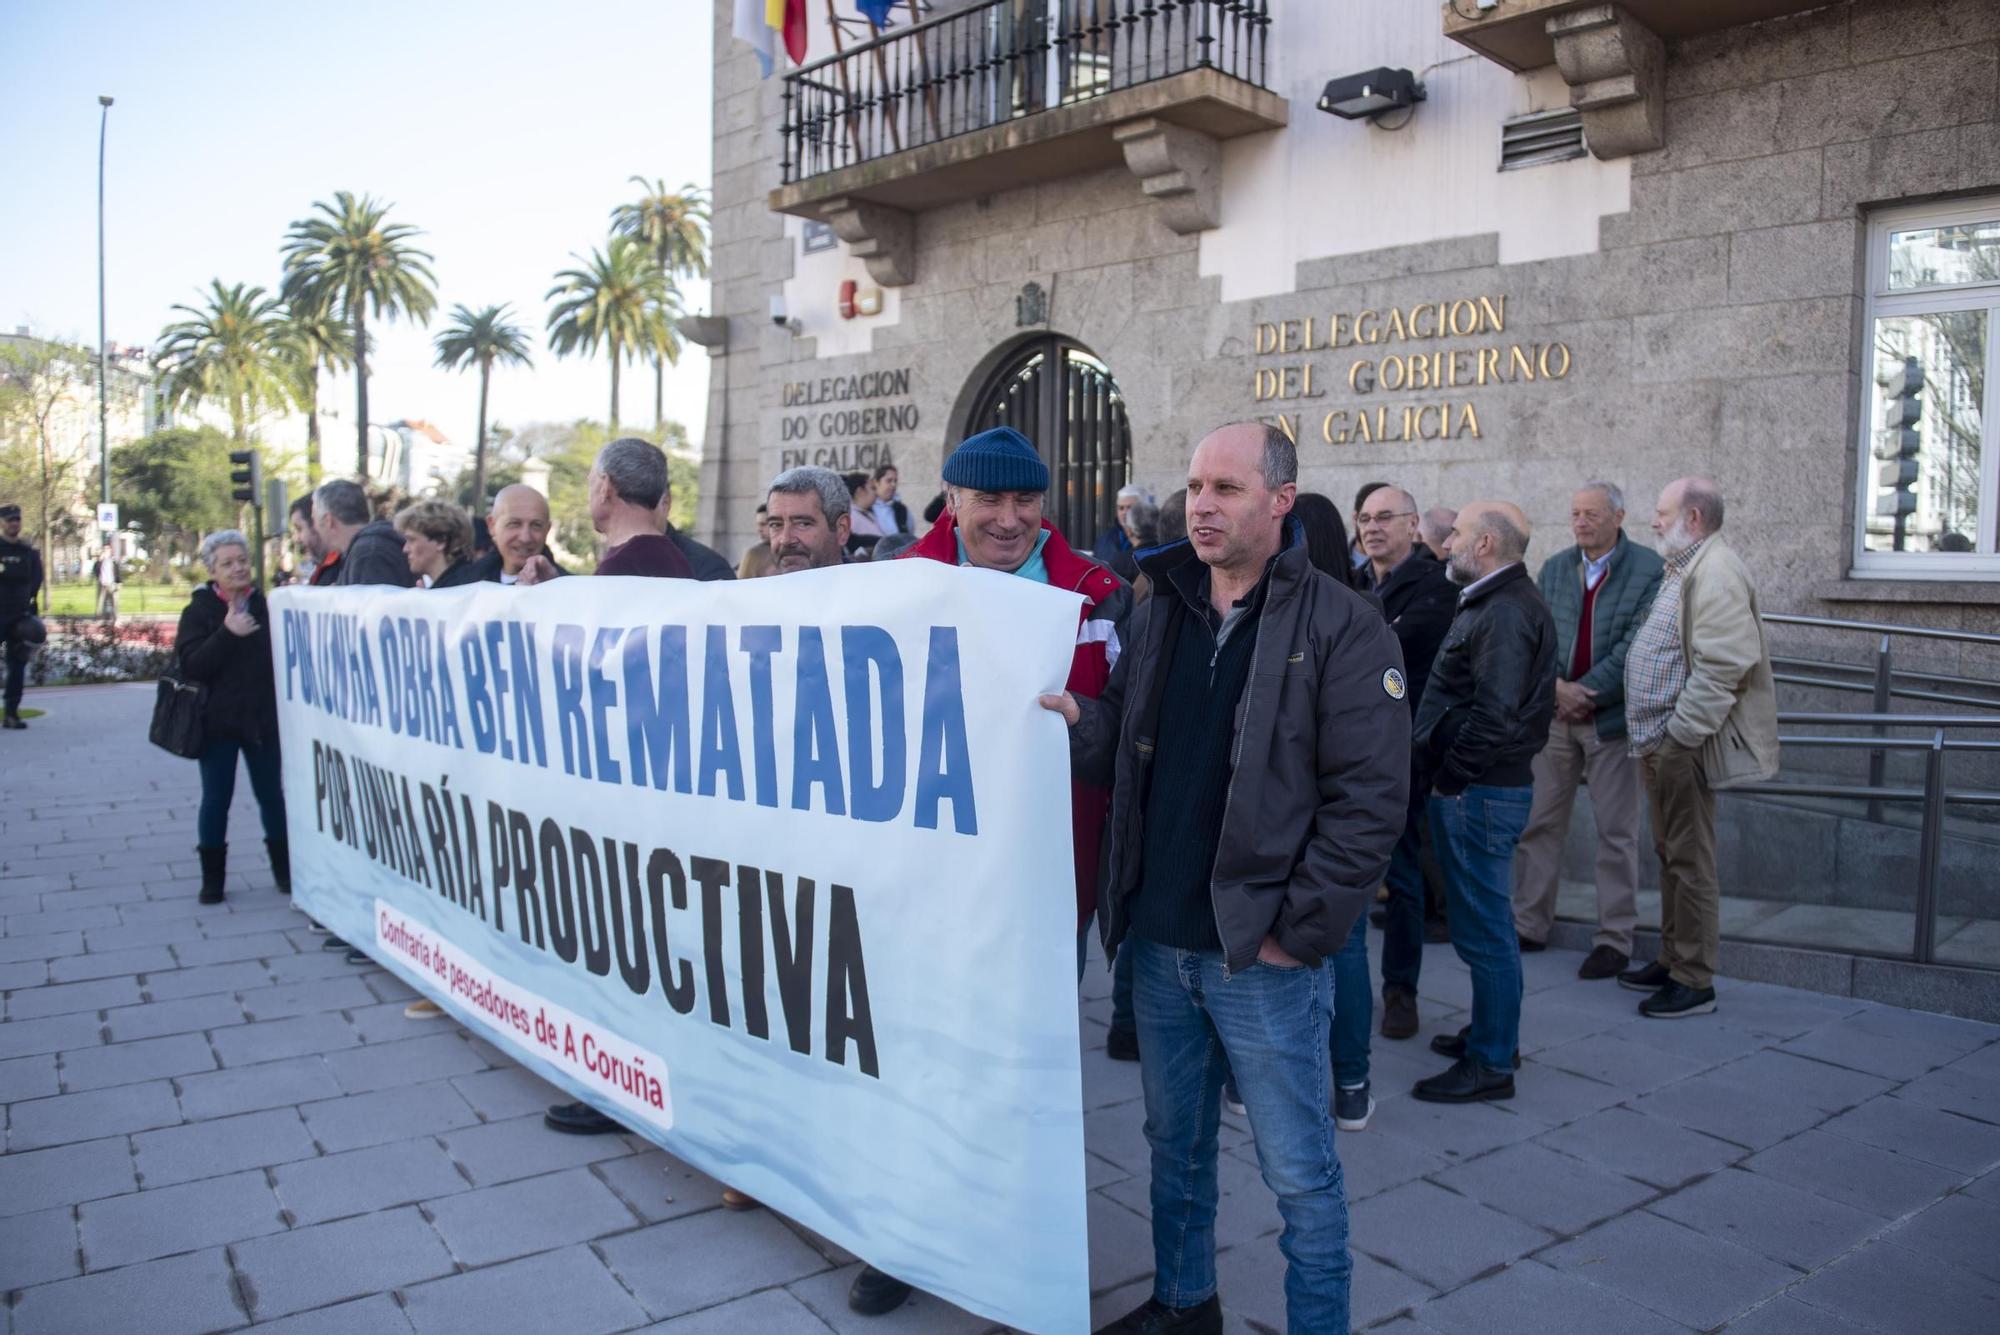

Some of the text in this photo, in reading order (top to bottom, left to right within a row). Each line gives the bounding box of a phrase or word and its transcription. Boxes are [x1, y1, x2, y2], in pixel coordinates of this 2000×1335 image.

[1255, 294, 1506, 355] DELEGACION
[782, 368, 911, 407] DELEGACION
[1255, 342, 1572, 401] DEL GOBIERNO
[781, 404, 919, 441] DO GOBERNO
[1255, 402, 1482, 447] N GALICIA
[814, 443, 893, 472] GALICIA
[283, 609, 979, 836] POR UNHA OBRA BEN REMATADA
[313, 739, 880, 1079] POR UNHA RÍA PRODUCTIVA
[381, 911, 665, 1110] Confraría de pescadores de A Coruña
